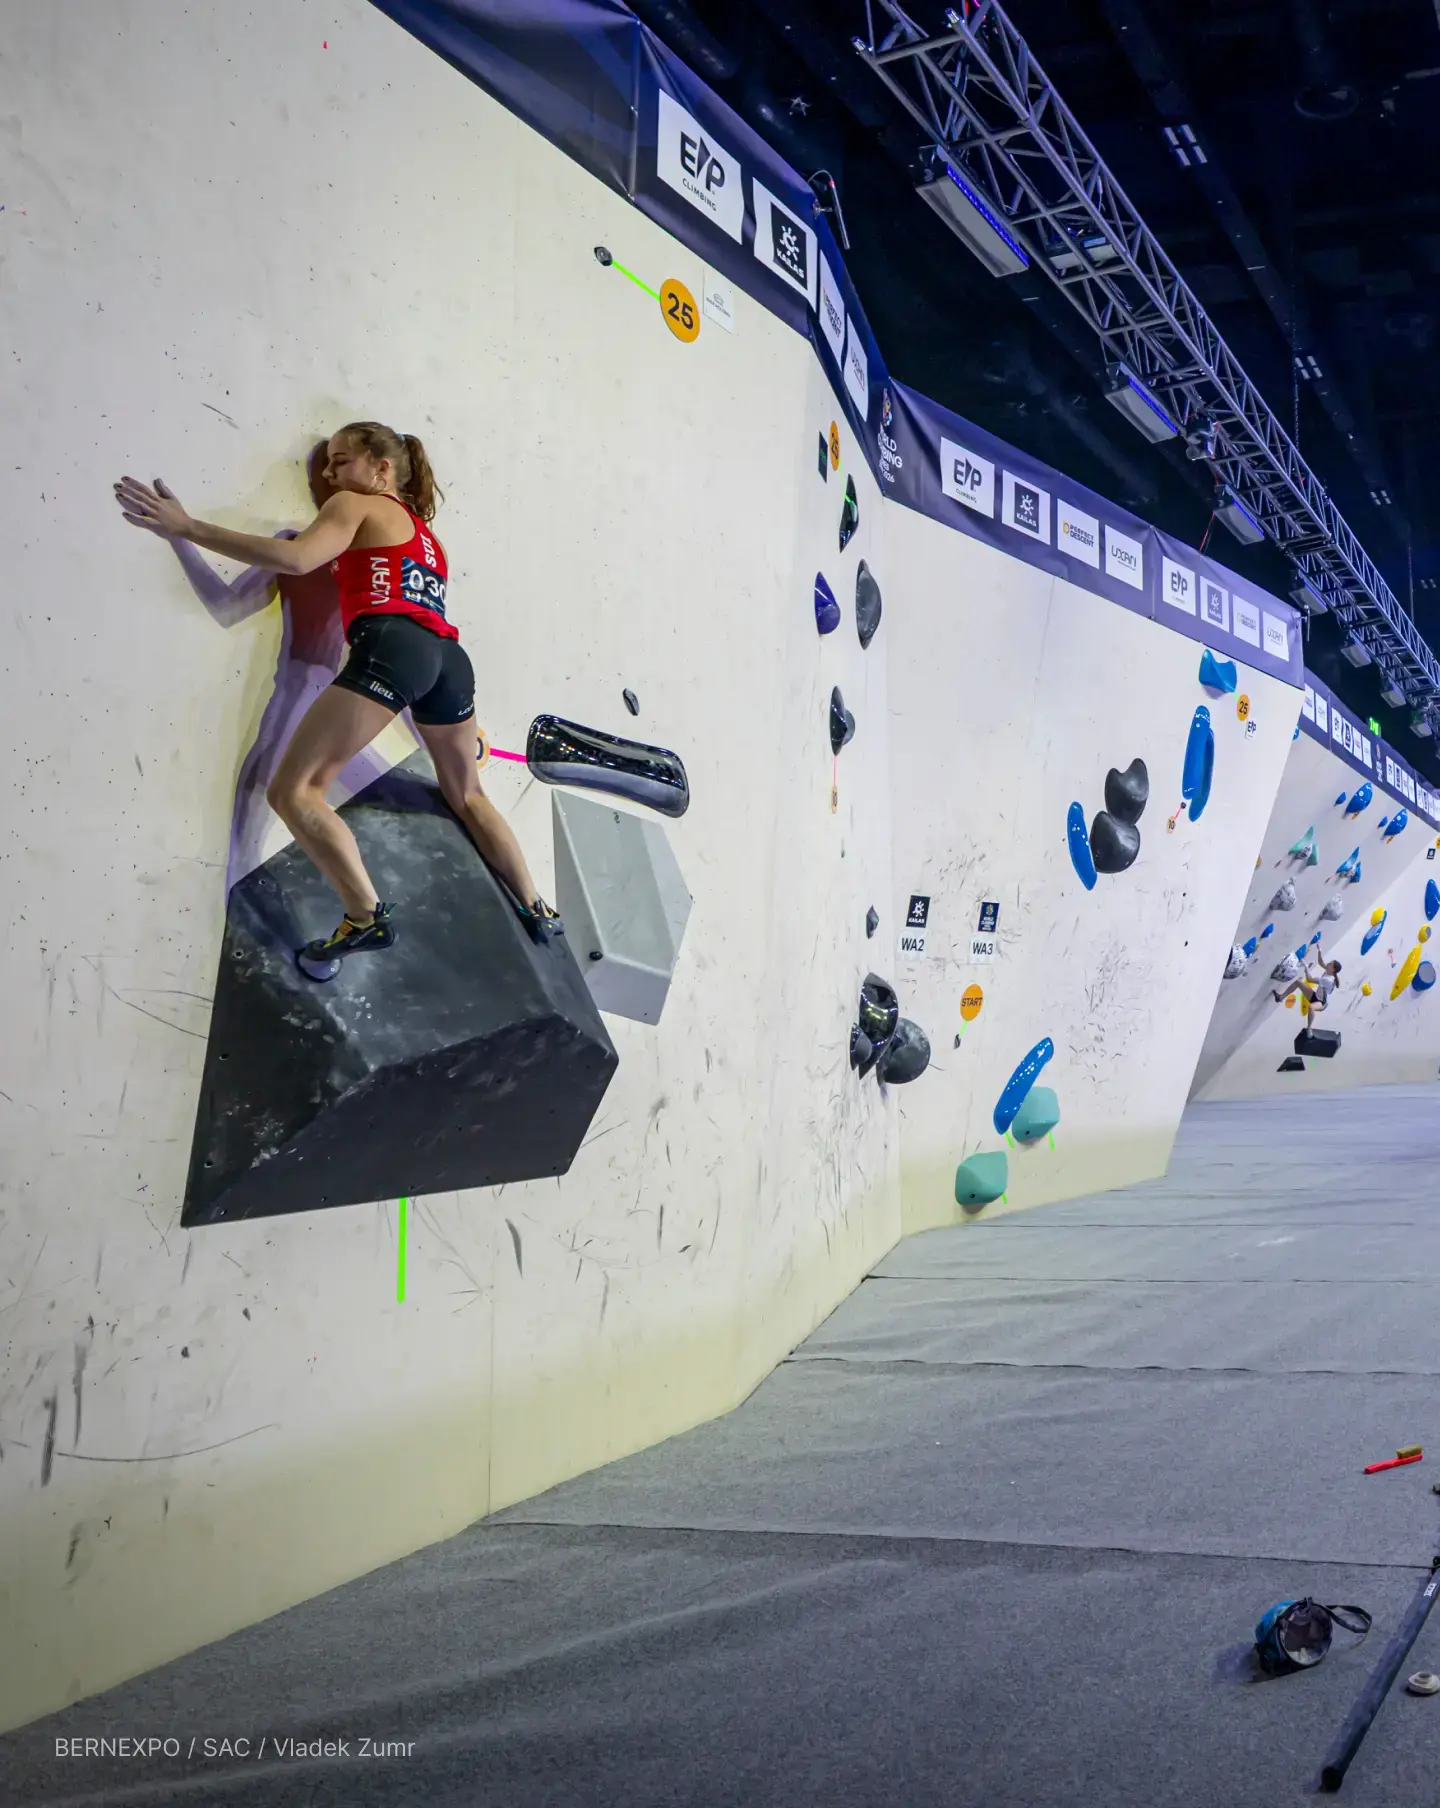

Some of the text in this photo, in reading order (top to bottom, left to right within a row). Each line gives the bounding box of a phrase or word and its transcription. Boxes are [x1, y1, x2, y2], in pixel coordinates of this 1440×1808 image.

[682, 178, 717, 212] CLIMBING
[776, 248, 805, 279] KAILAS
[667, 292, 694, 330] 25
[1016, 512, 1037, 527] KAILAS
[1069, 524, 1094, 541] PERFECT
[1069, 531, 1094, 547] DESCENT
[420, 533, 437, 568] SUI
[1239, 701, 1248, 715] 25
[1168, 819, 1175, 830] 10
[901, 937, 925, 951] WA2
[972, 943, 994, 955] WA3
[961, 997, 983, 1007] START
